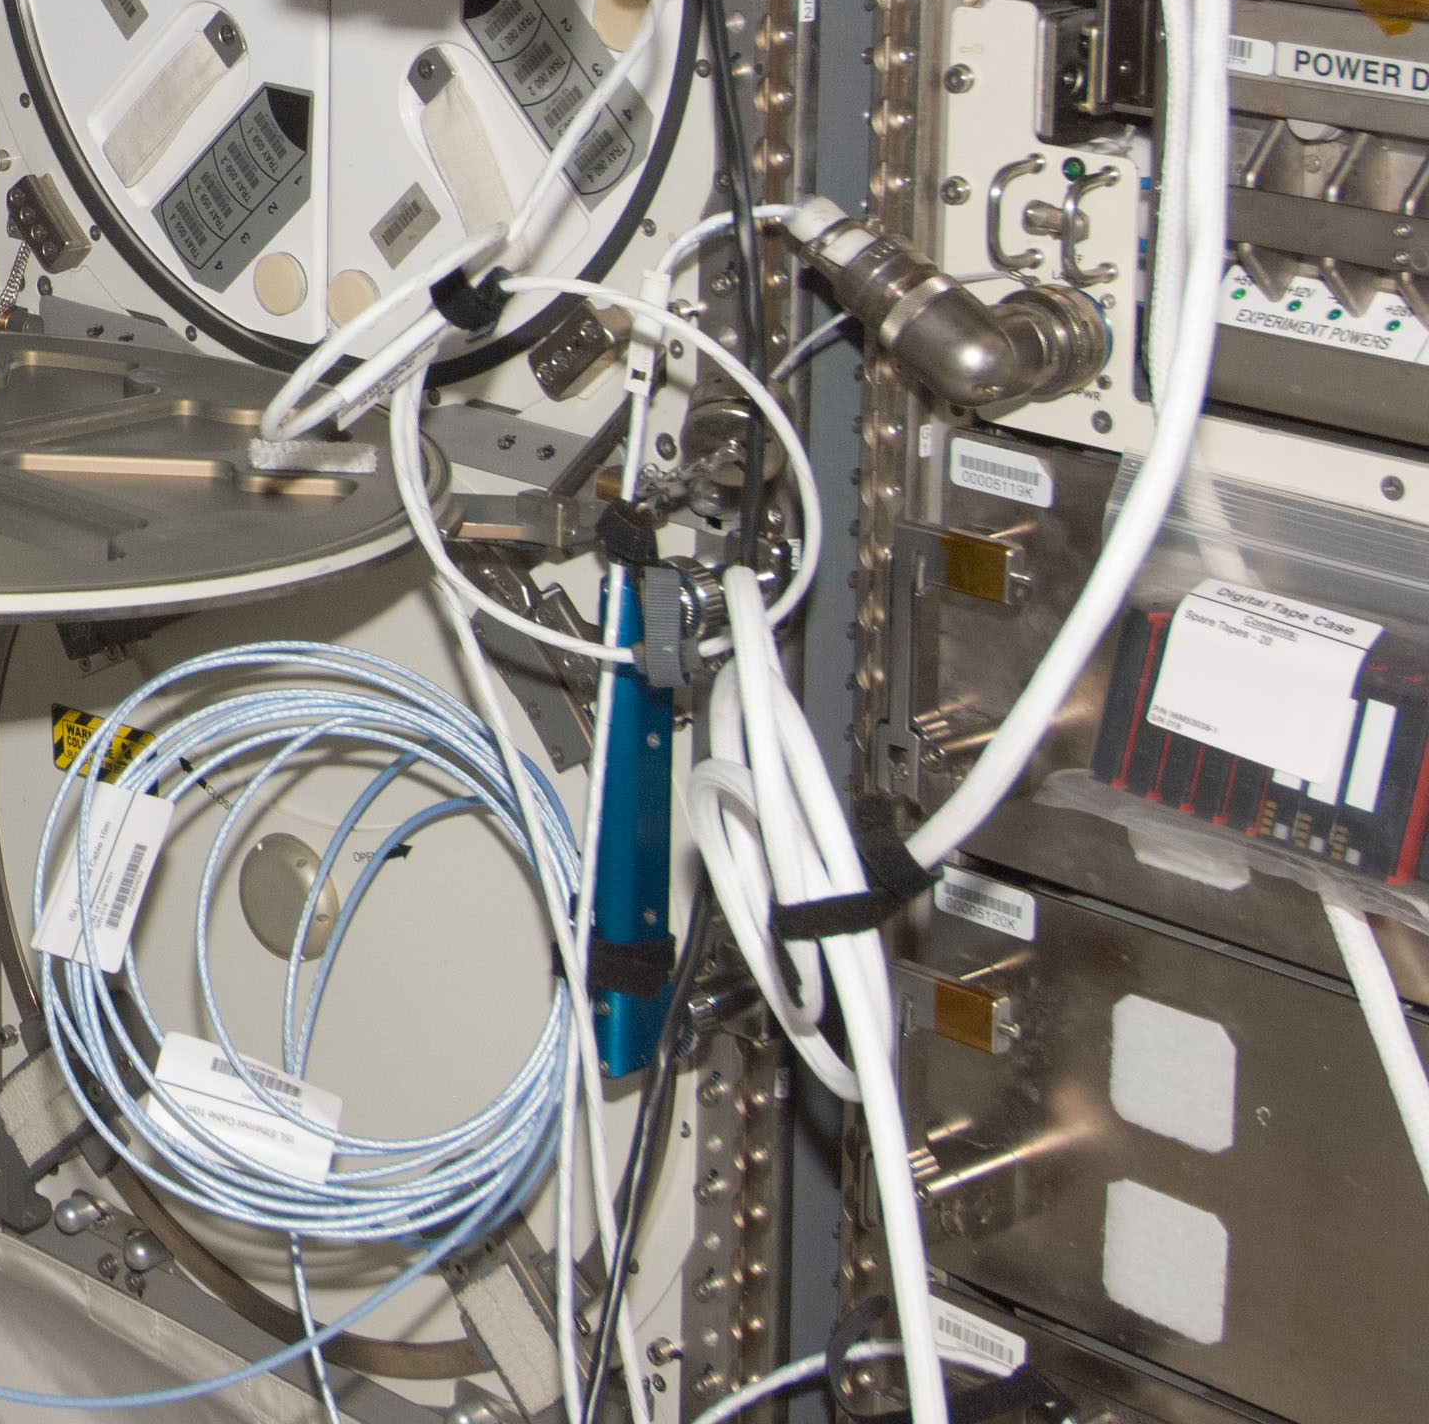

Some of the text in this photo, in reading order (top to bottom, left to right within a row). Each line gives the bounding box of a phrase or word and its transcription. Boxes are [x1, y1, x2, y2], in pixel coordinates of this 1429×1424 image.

[515, 11, 537, 34] TRAY
[559, 17, 573, 32] 2
[545, 55, 567, 78] TRAY
[591, 63, 603, 78] 3
[1294, 50, 1402, 87] POWER
[621, 107, 633, 122] 4
[262, 150, 279, 174] TRAY
[606, 143, 628, 167] TRAY
[234, 179, 252, 203] TRAY
[293, 176, 303, 185] 1
[208, 207, 226, 233] TRAY
[267, 202, 279, 215] 2
[182, 235, 201, 260] TRAY
[240, 232, 251, 244] 3
[214, 261, 223, 271] 4
[1235, 308, 1393, 350] EXPERIMENT POWERS
[1216, 586, 1355, 635] Digital Tape Case
[1183, 609, 1217, 628] Spare
[1218, 620, 1249, 638] Tapes
[208, 1110, 235, 1127] Cable
